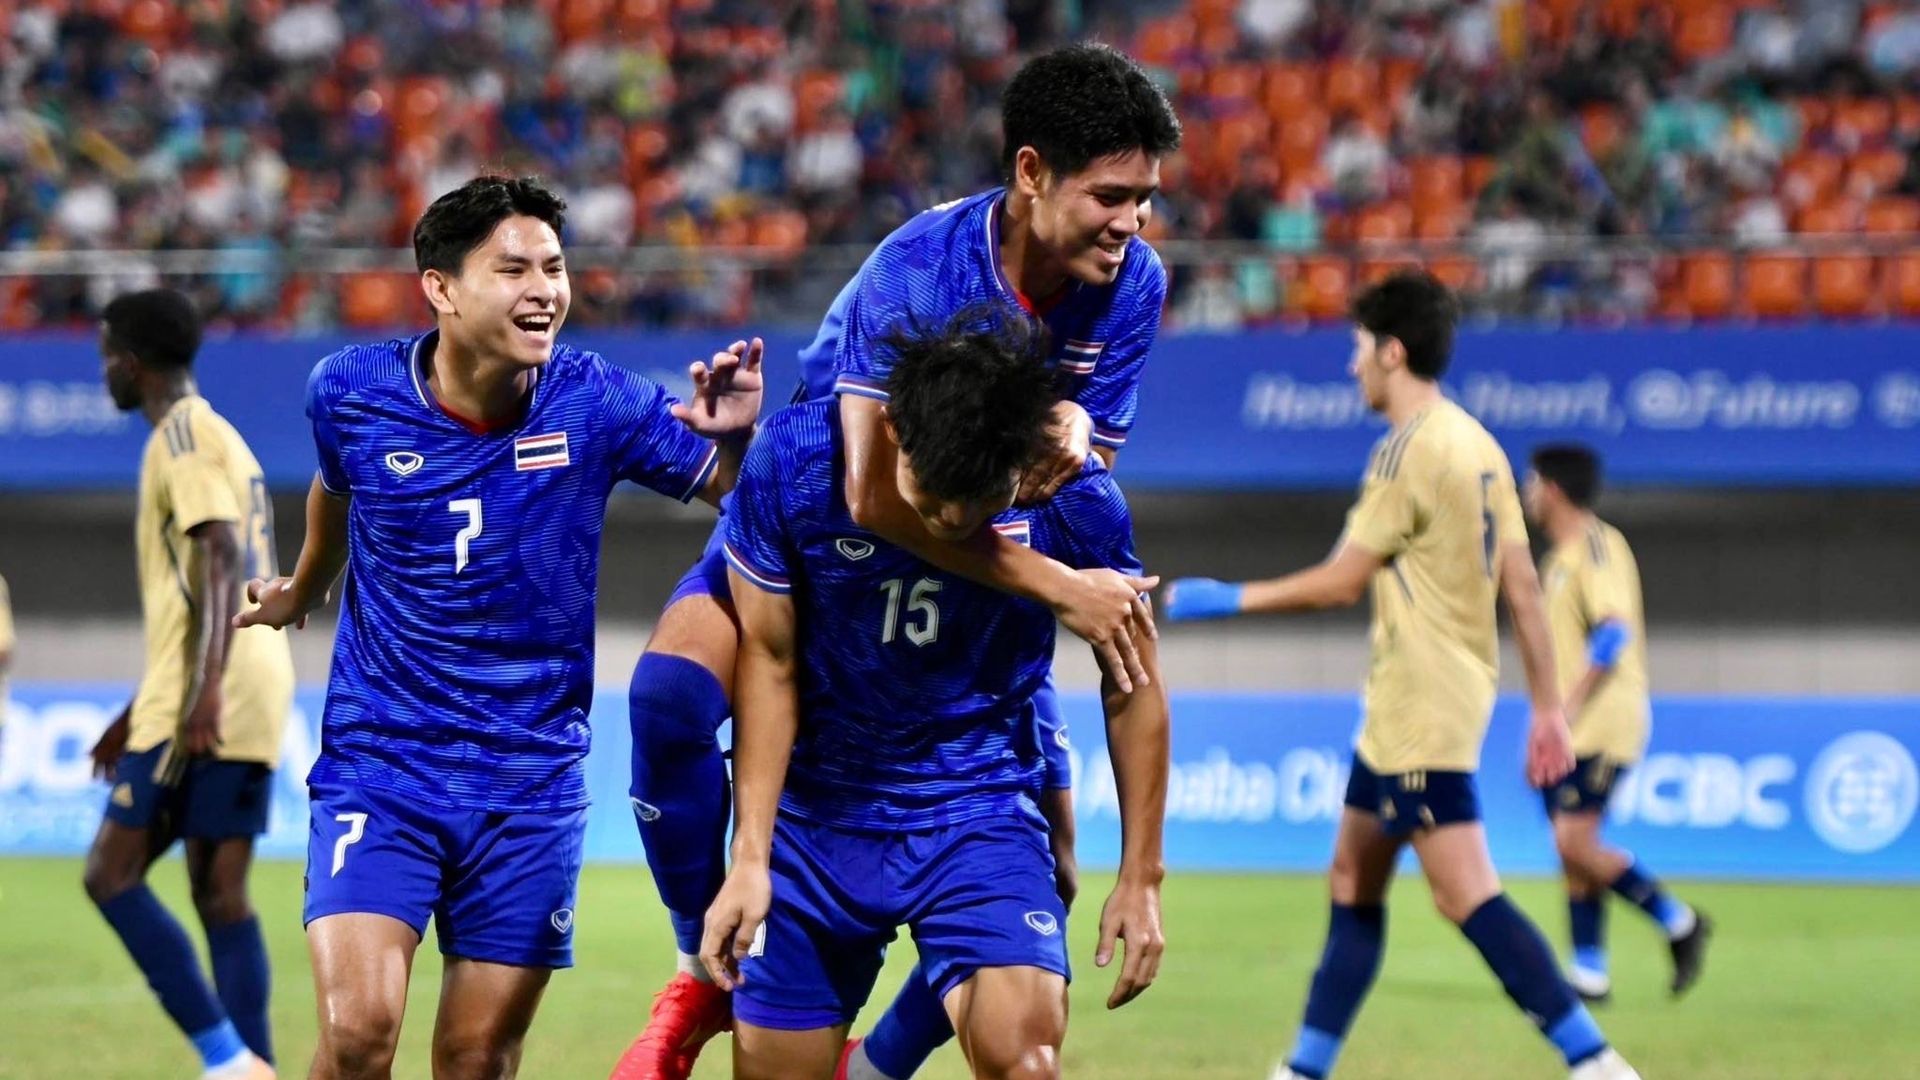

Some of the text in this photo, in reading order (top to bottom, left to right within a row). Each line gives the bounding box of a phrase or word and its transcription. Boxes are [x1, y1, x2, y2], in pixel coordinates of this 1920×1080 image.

[448, 498, 482, 574] 7
[879, 576, 943, 647] 15
[331, 813, 368, 879] 7
